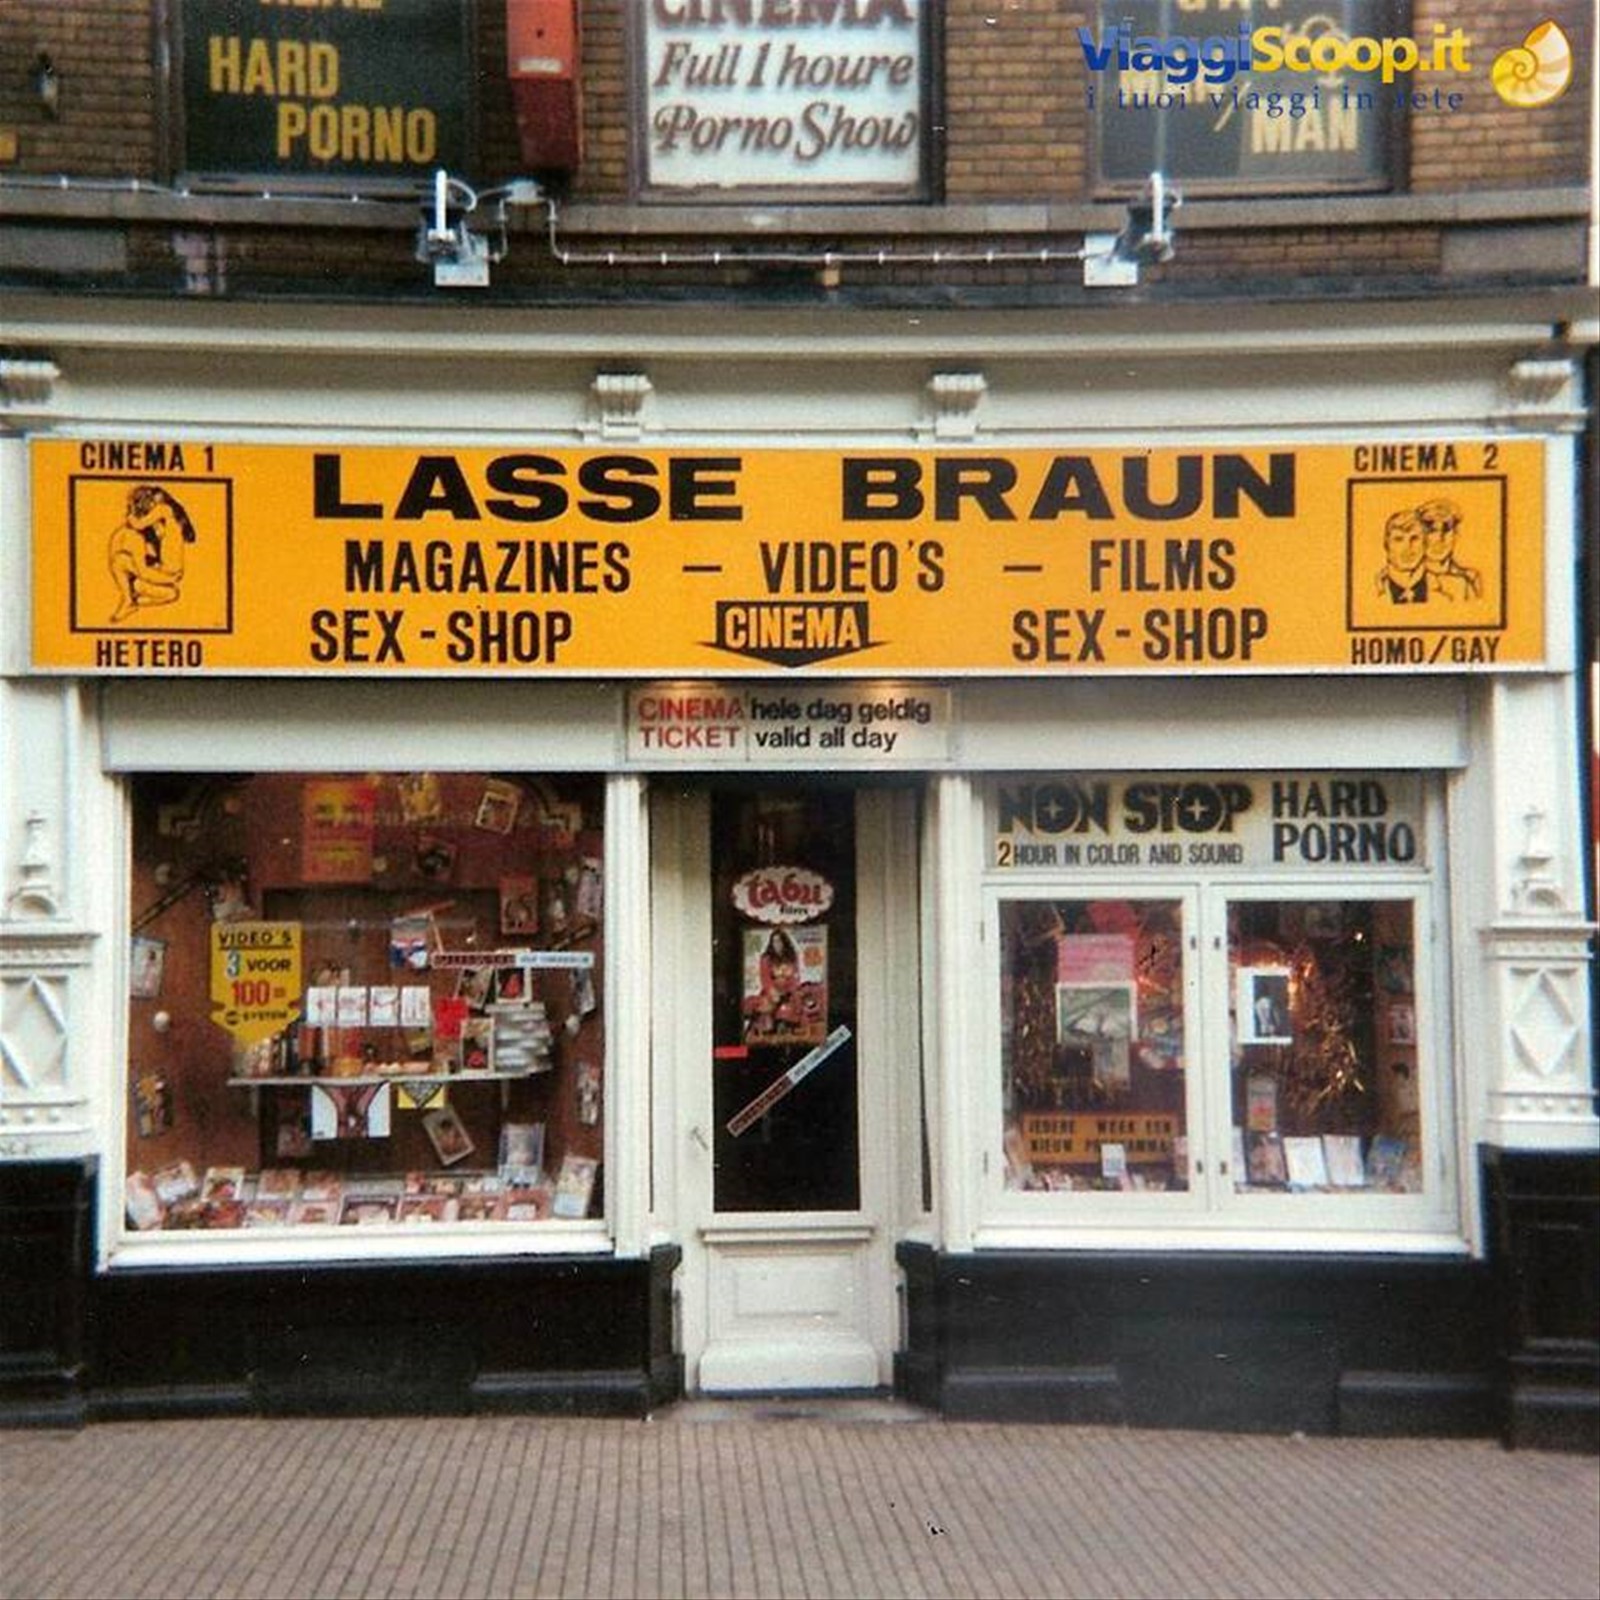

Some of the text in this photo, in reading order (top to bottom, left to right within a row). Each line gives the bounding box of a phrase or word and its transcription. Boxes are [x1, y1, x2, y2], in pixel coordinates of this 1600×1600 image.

[209, 37, 338, 97] HARD
[652, 42, 742, 86] Full
[777, 43, 914, 88] houre
[277, 105, 436, 163] PORNO
[654, 101, 920, 161] Porno Show
[1252, 97, 1358, 153] MAN
[81, 443, 215, 472] CINEMA 1
[1354, 445, 1499, 472] CINEMA 2
[313, 453, 1295, 523] LASSE BRAUN
[345, 539, 630, 594] MAGAZINES
[760, 540, 944, 594] VIDEO'S
[1090, 538, 1236, 592] FILMS
[724, 605, 861, 649] CINEMA
[96, 640, 203, 668] HETERO
[1351, 635, 1501, 665] HOMO/GAY
[638, 698, 745, 721] CINEMA
[752, 698, 931, 723] hele dag geldig
[639, 726, 741, 749] TICKET
[756, 726, 897, 752] valid all day
[999, 782, 1253, 834] NON STOP
[1272, 781, 1387, 818] HARD
[998, 841, 1244, 867] 2 HOUR IN COLOR AND SOUND
[1273, 822, 1416, 864] PORNO
[227, 950, 292, 978] 3 VOOR
